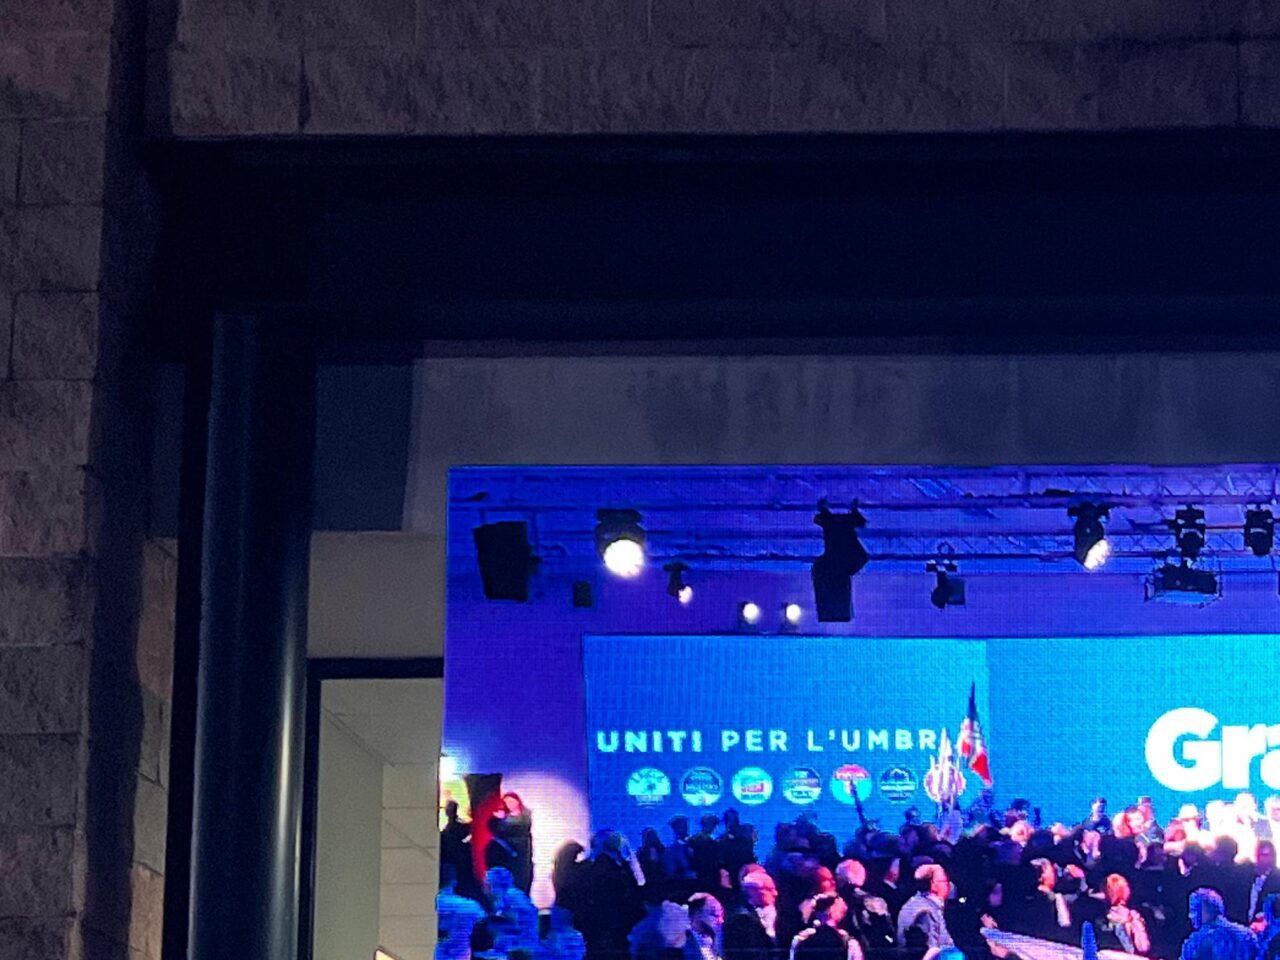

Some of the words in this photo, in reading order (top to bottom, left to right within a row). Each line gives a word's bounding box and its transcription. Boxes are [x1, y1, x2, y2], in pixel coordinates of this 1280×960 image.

[597, 729, 702, 753] UNITI
[721, 729, 789, 753] PER
[807, 728, 938, 752] L'UMBR
